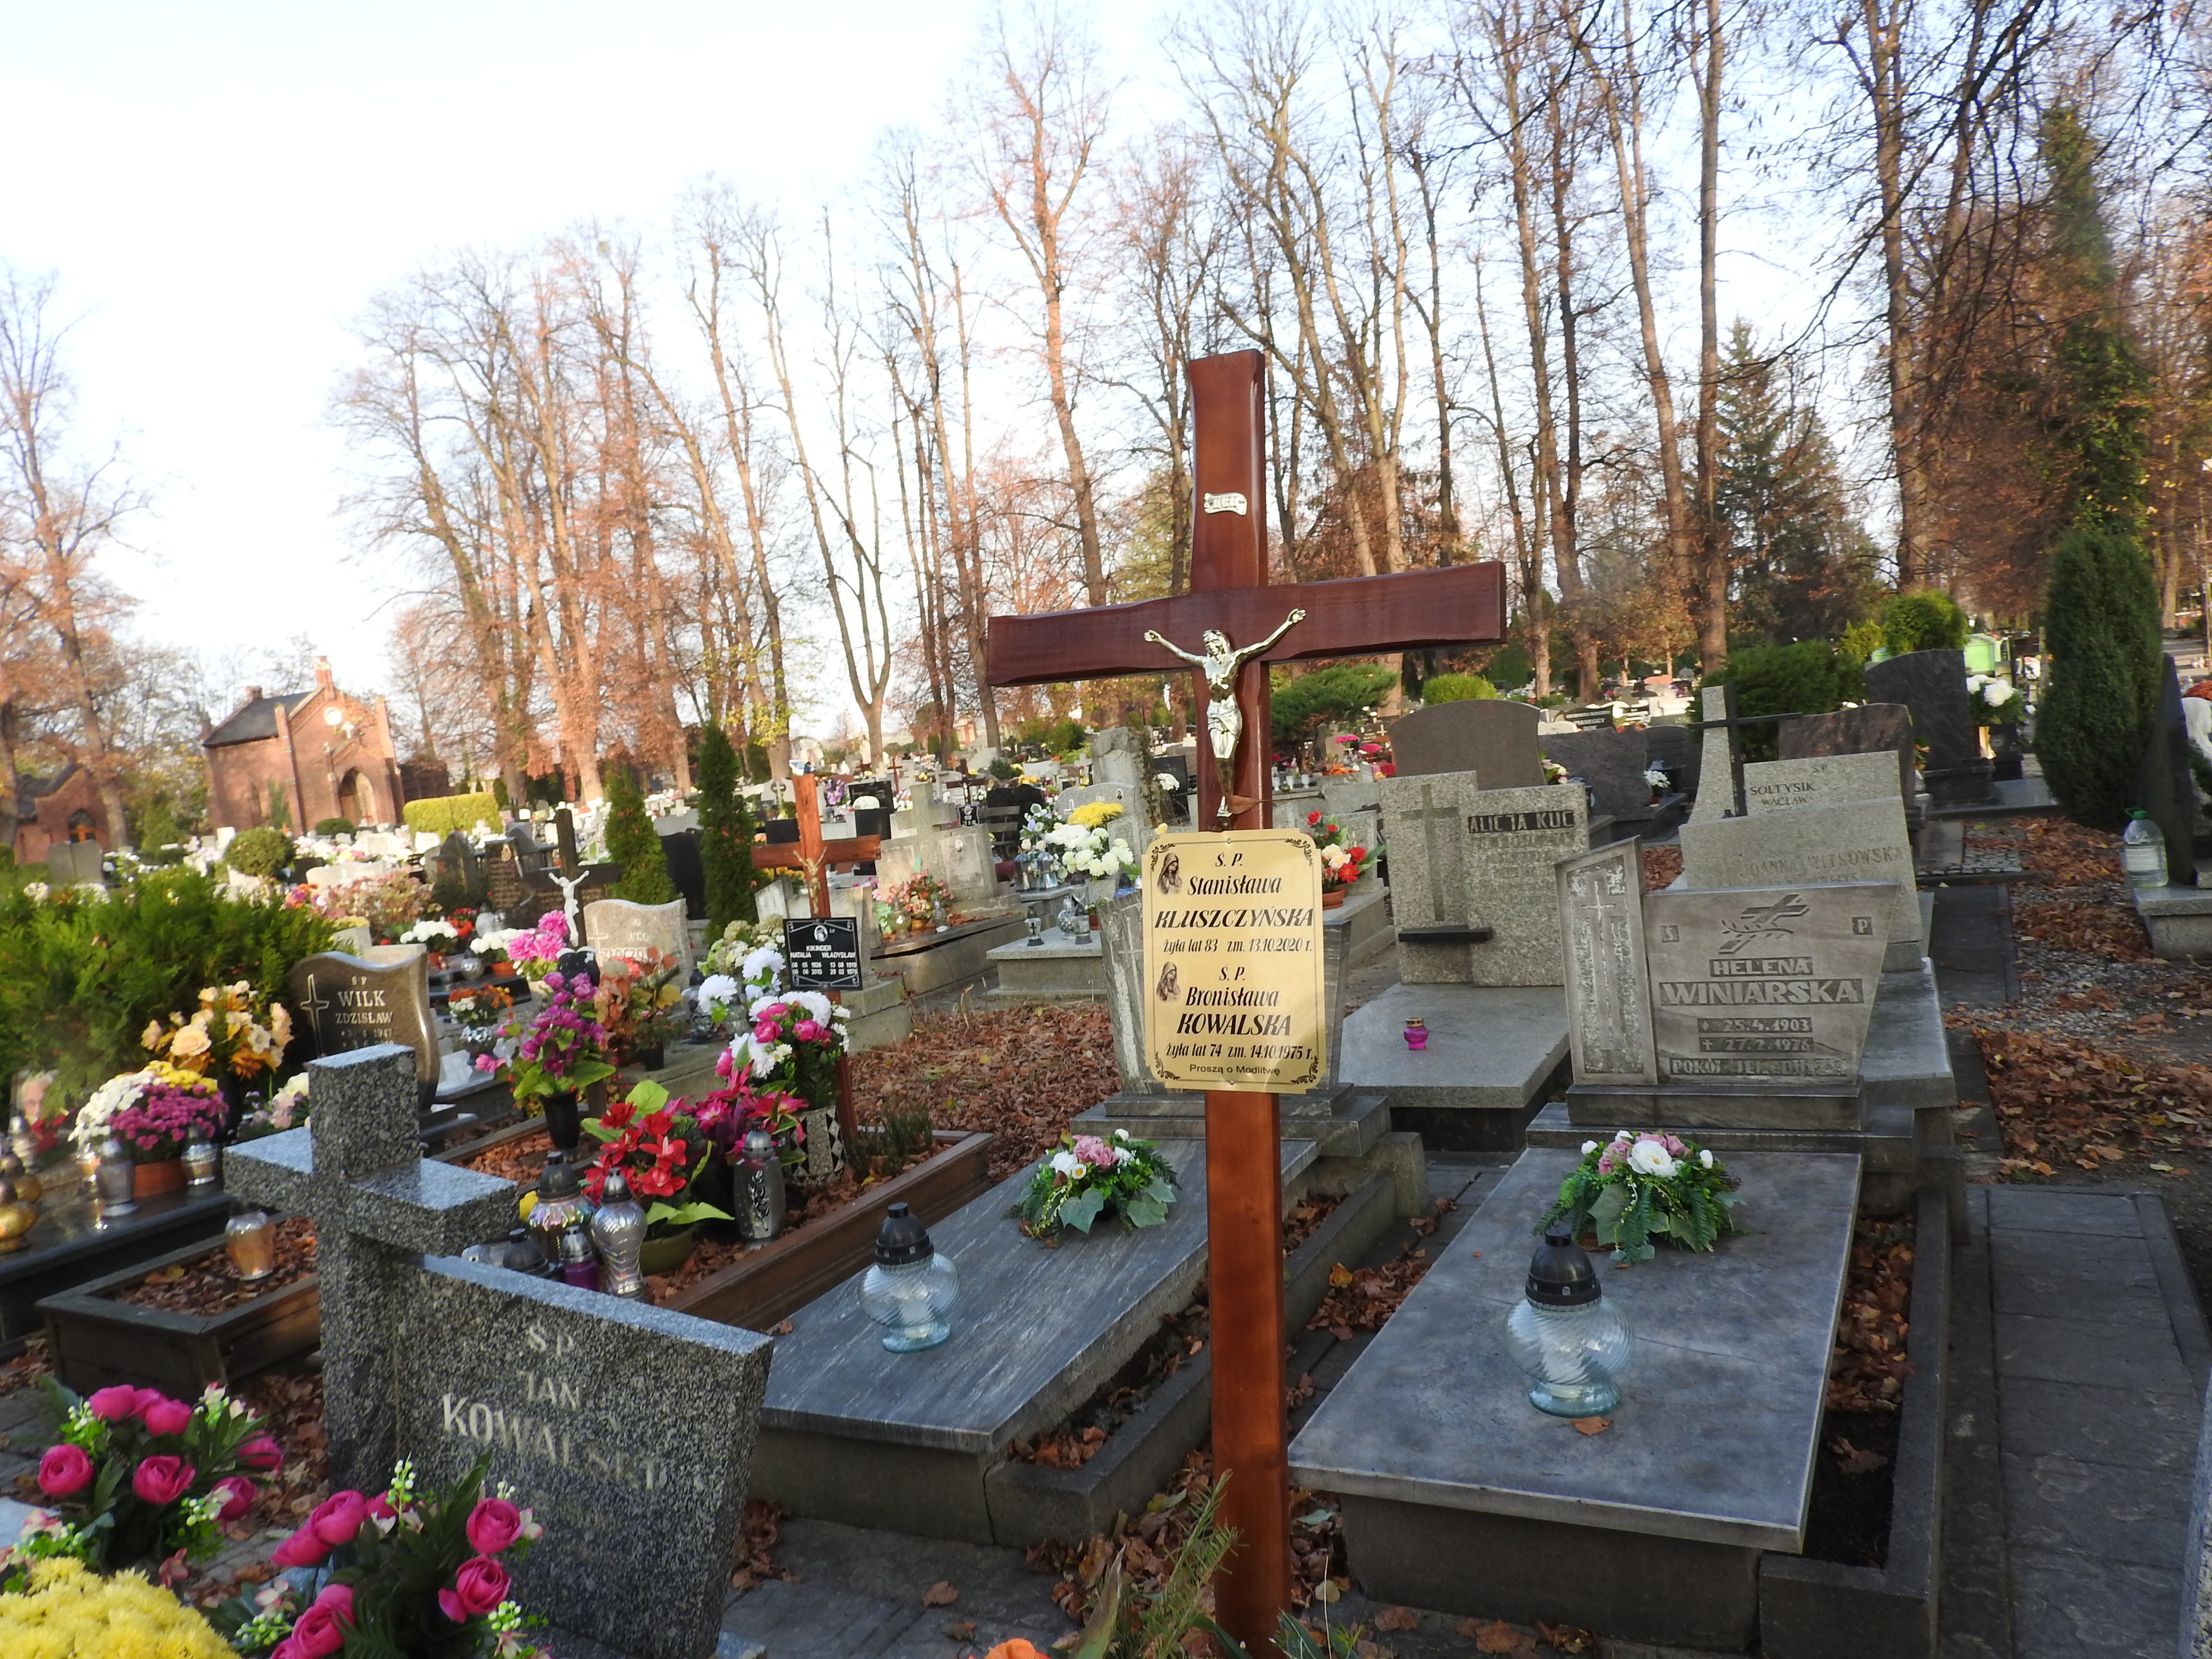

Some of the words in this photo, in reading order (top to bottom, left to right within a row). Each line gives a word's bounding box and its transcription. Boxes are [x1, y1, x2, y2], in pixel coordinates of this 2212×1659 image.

[1470, 815, 1527, 833] ALICJA
[1537, 811, 1574, 828] KUC
[1215, 852, 1226, 867] Ś.
[1231, 853, 1243, 866] P.
[1188, 875, 1282, 896] Stanisława
[1154, 906, 1314, 928] KLUSZCZYŃSKA
[1858, 919, 1868, 932] P
[1164, 938, 1185, 955] żyła
[1188, 938, 1202, 952] lat
[1205, 938, 1218, 952] 83
[1227, 941, 1245, 952] zm.
[1249, 938, 1303, 952] 13.10.2020
[1306, 940, 1312, 951] r.
[1219, 964, 1229, 981] Ś.
[1234, 966, 1245, 981] P.
[1713, 959, 1811, 975] HELENA
[337, 990, 385, 1007] WILK
[1186, 986, 1279, 1007] Bronisława
[1662, 980, 1859, 1004] WINIARSKA
[1177, 1013, 1291, 1036] KOWALSKA
[1166, 1043, 1189, 1059] żyła
[1191, 1044, 1206, 1057] lat
[1210, 1044, 1222, 1057] 74
[1227, 1046, 1246, 1058] zm.
[1250, 1045, 1303, 1059] 14.10.1975
[1306, 1048, 1313, 1060] r.
[1190, 1064, 1223, 1075] Proszą
[1236, 1065, 1280, 1075] Modlitwę
